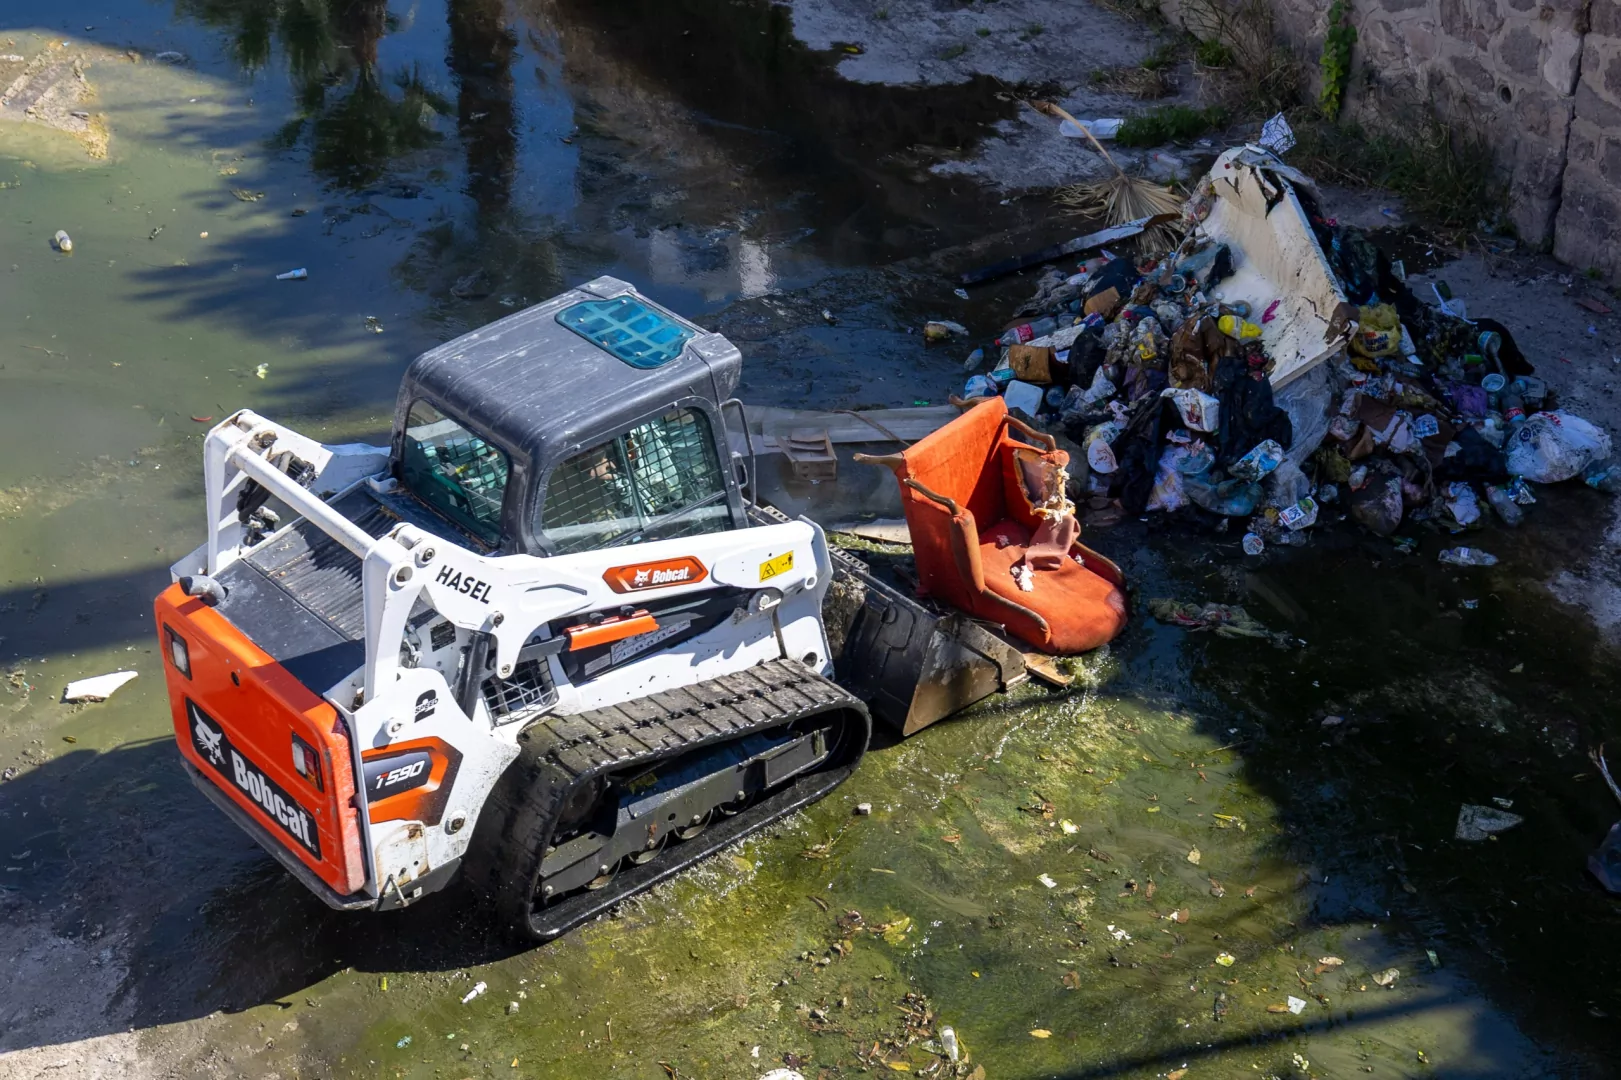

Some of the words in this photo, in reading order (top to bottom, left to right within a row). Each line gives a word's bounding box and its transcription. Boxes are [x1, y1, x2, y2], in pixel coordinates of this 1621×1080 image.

[435, 564, 492, 605] HASEL
[652, 566, 689, 584] Bobcat
[376, 760, 425, 790] T590
[231, 749, 312, 848] Bobcat
